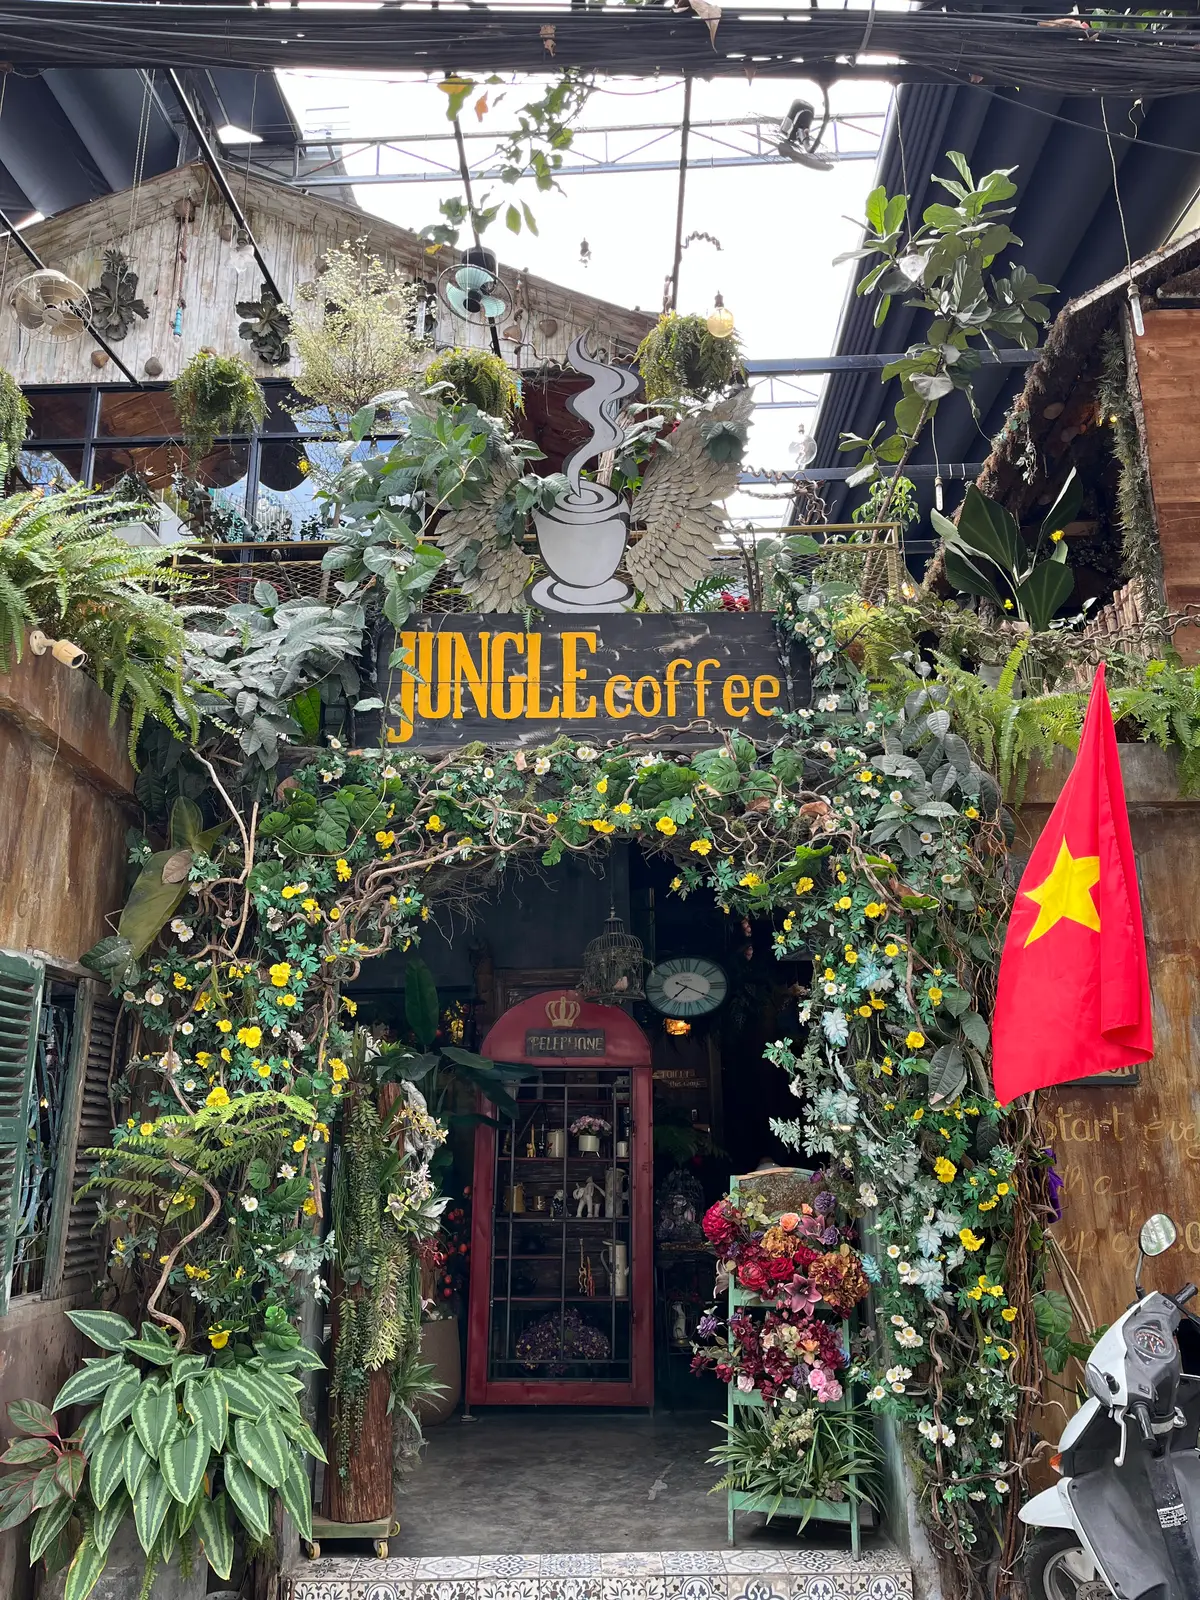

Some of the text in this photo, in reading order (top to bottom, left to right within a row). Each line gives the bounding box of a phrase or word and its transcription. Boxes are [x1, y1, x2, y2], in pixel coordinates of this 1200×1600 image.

[387, 631, 781, 743] JUNGLE coffee
[1143, 1119, 1200, 1144] eve
